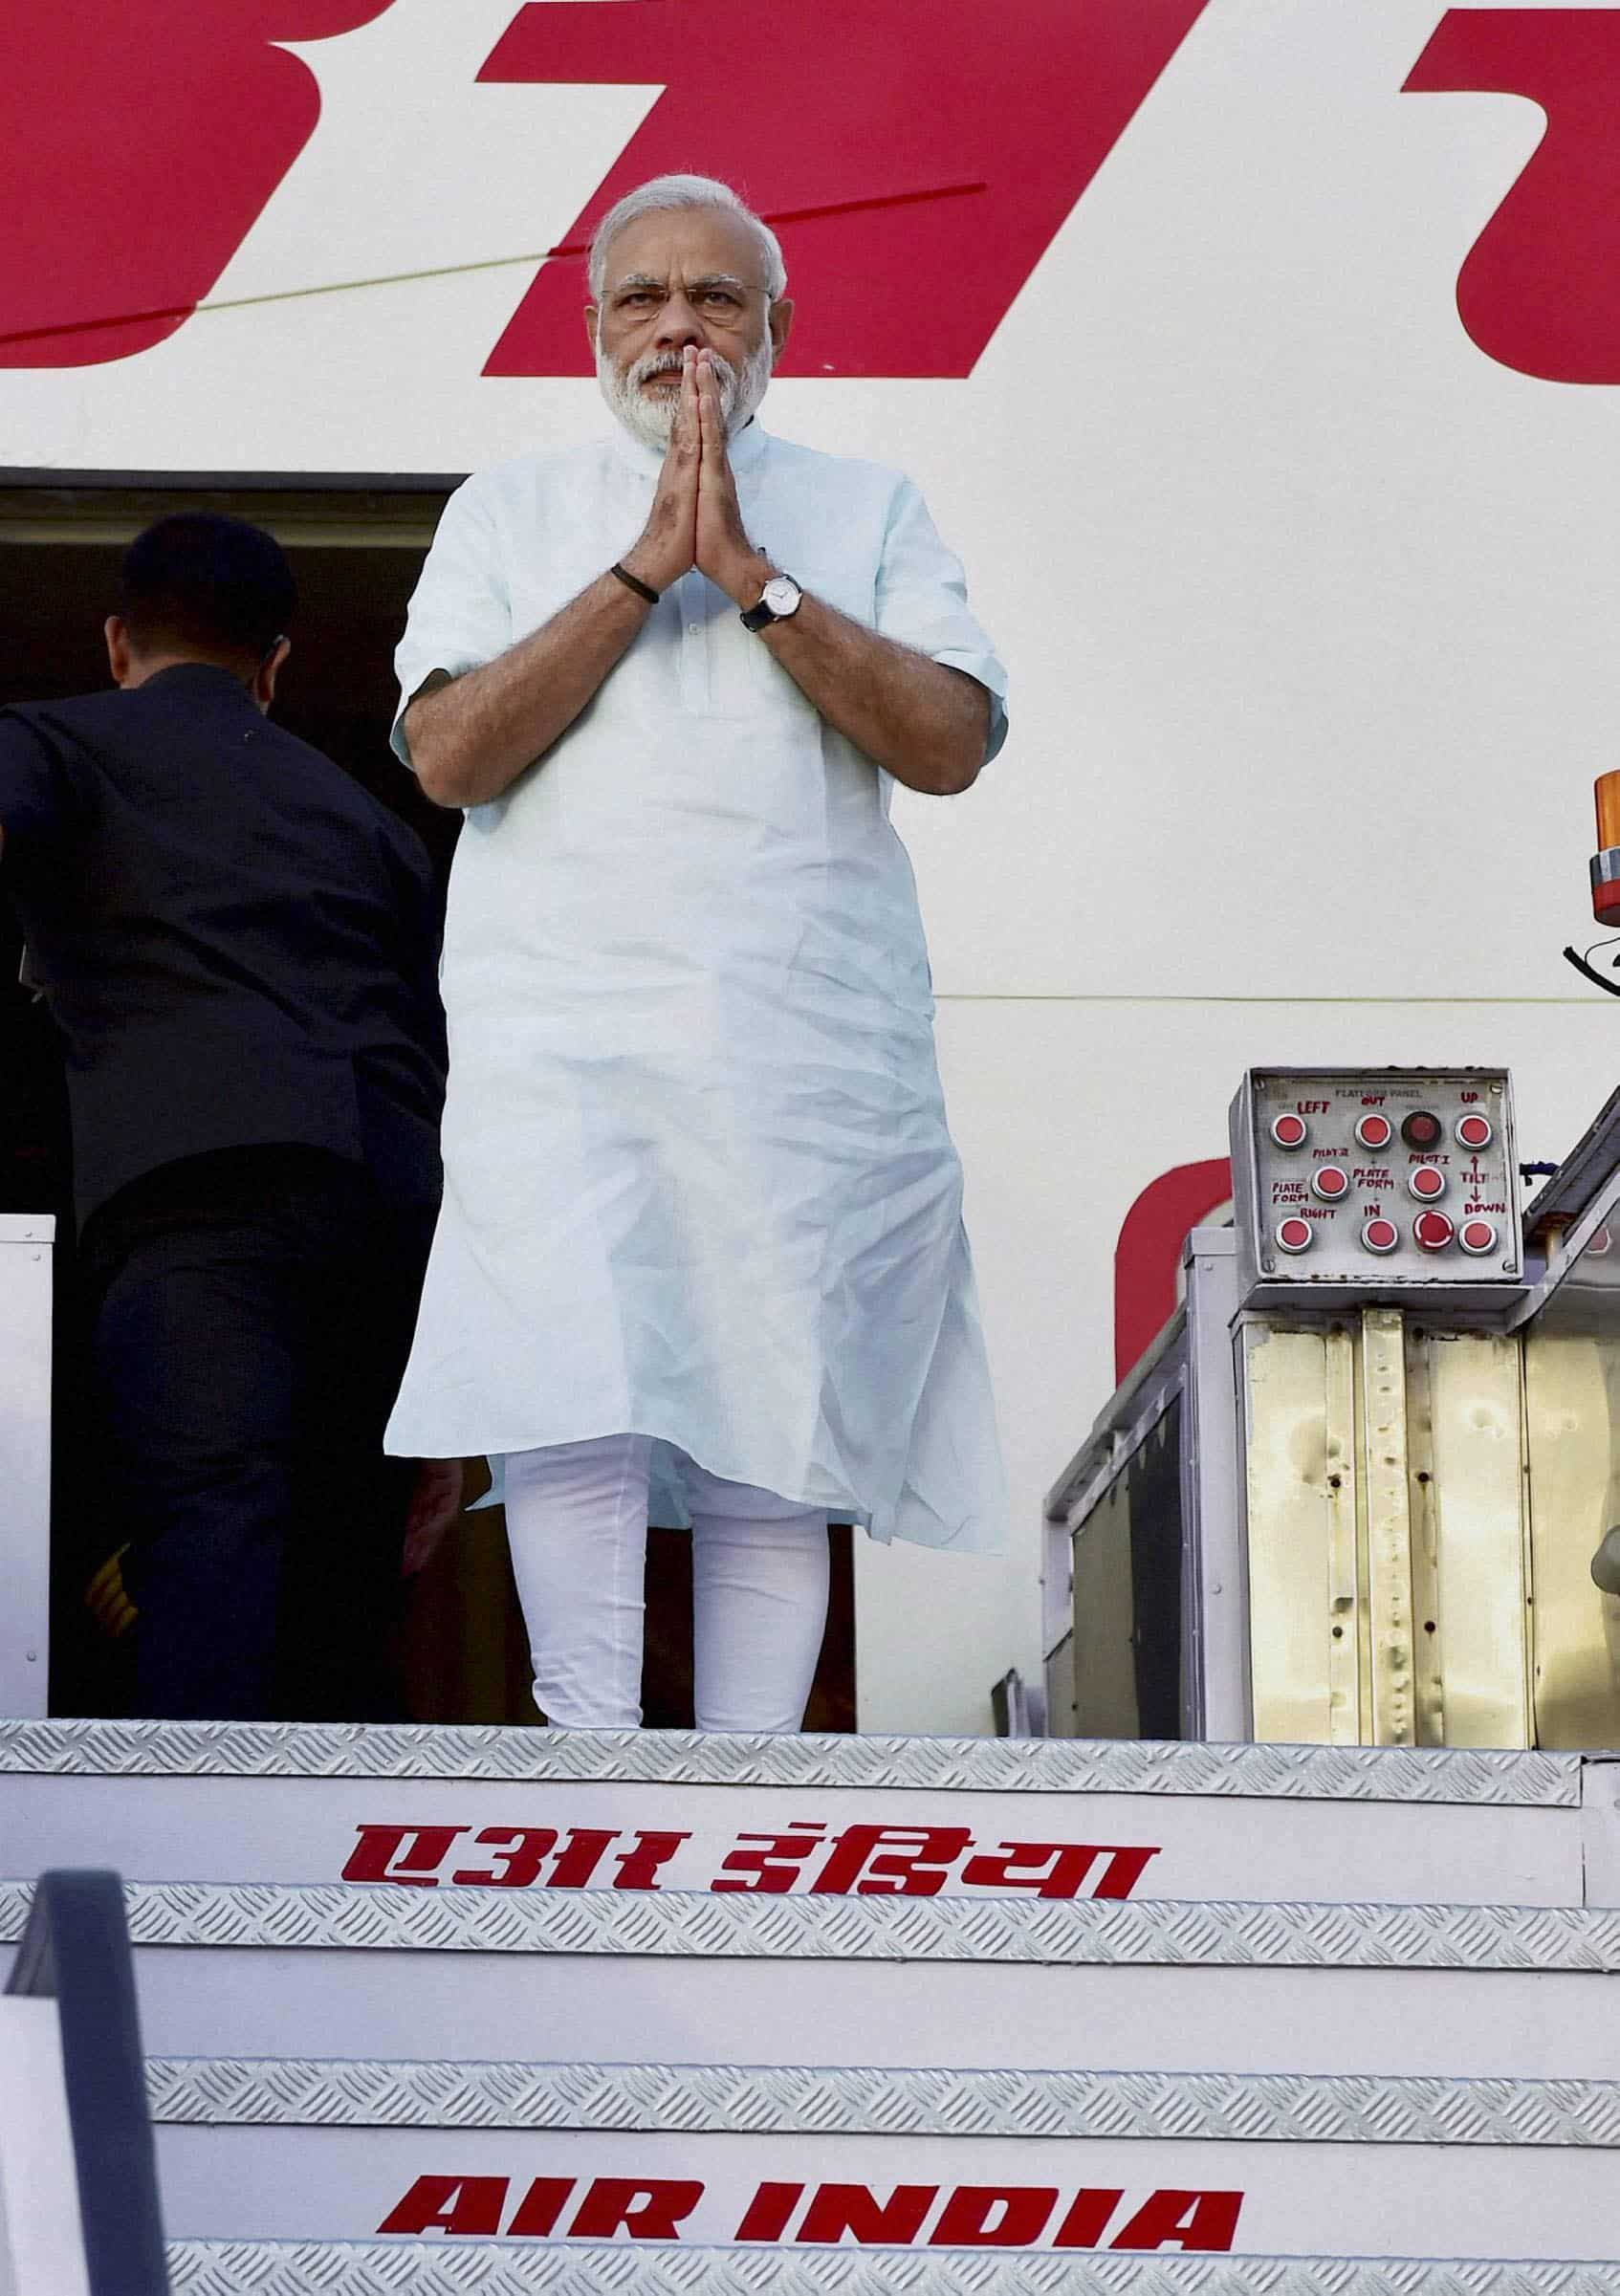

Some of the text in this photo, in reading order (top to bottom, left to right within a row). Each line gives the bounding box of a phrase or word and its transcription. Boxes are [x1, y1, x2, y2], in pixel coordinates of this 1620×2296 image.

[1361, 1096, 1386, 1106] OUT
[1460, 1091, 1479, 1104] UP
[1297, 1101, 1330, 1115] LEFT
[1352, 1169, 1390, 1179] PLATE
[1272, 1182, 1304, 1193] PLATE
[1357, 1178, 1394, 1190] FORM
[1272, 1192, 1309, 1204] FORM
[1300, 1208, 1337, 1219] RIGHT
[1364, 1205, 1381, 1217] IN
[1464, 1203, 1506, 1215] DOWN
[711, 1823, 1160, 1899] इंडिया
[381, 2176, 1243, 2251] AIR INDIA
